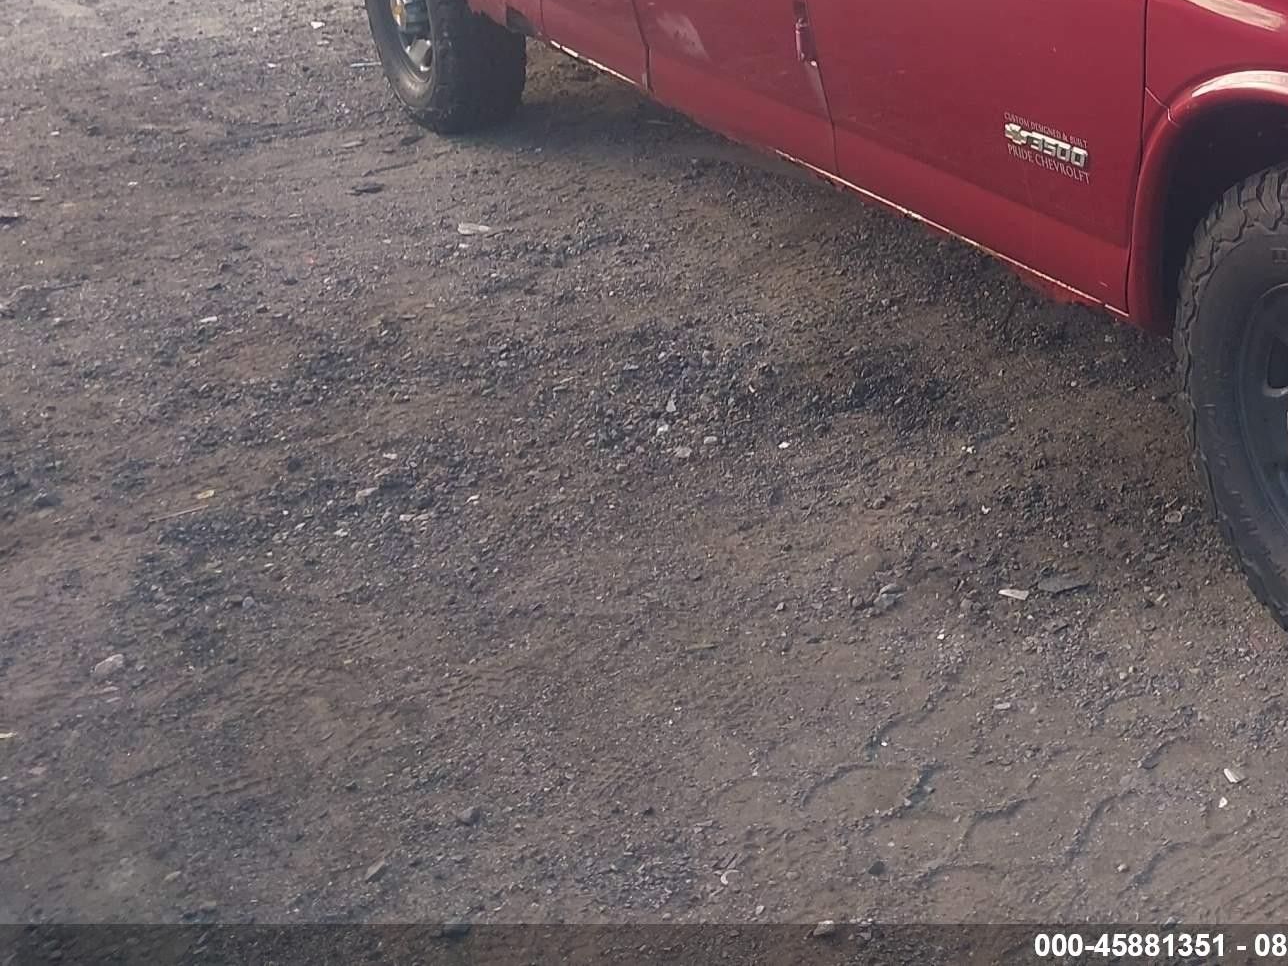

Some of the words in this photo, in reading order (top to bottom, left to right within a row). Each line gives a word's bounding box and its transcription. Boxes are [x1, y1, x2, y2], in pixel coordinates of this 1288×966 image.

[1004, 112, 1029, 128] CUSTOM
[1008, 143, 1034, 163] PRIDE
[1035, 154, 1090, 185] CHEVROLET
[1028, 131, 1088, 167] 3500
